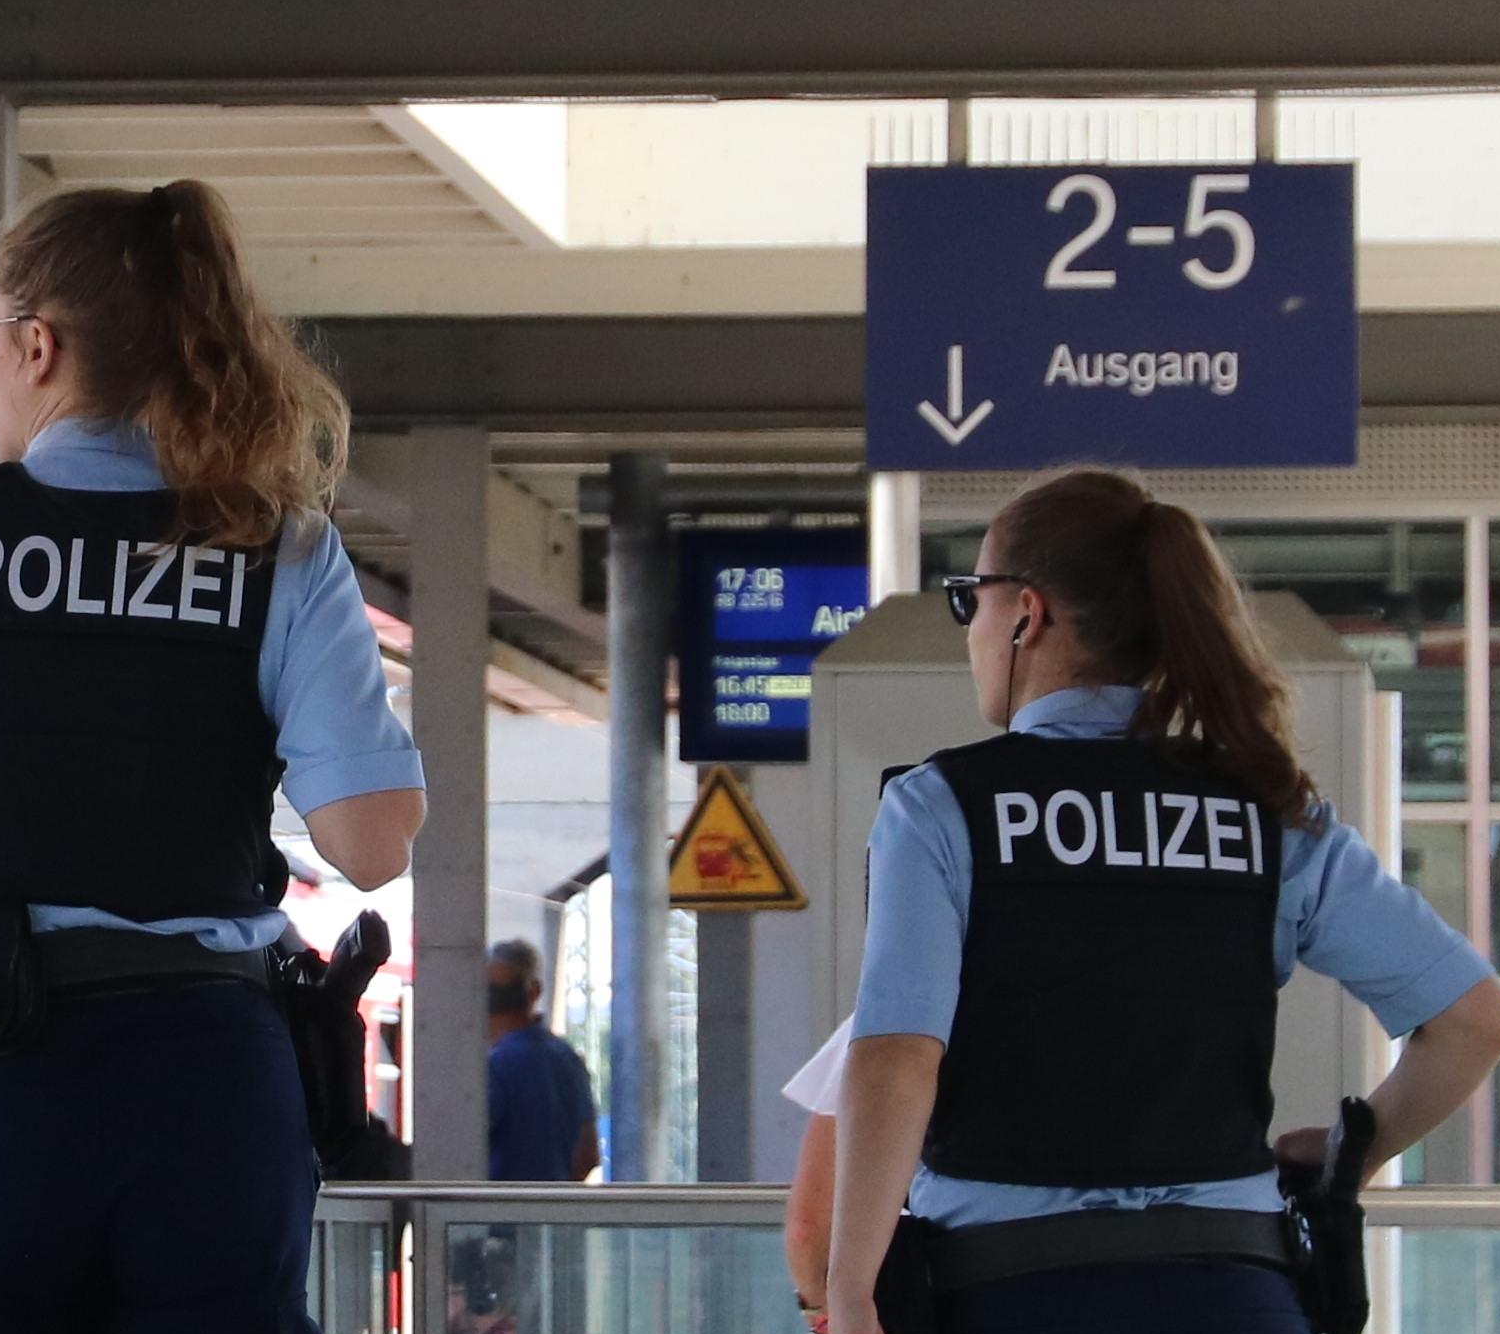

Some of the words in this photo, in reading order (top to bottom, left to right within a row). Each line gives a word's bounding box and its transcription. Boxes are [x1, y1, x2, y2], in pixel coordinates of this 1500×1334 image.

[1044, 173, 1256, 291] 2-5
[1044, 342, 1239, 397] Ausgang
[994, 788, 1264, 875] POLIZEI
